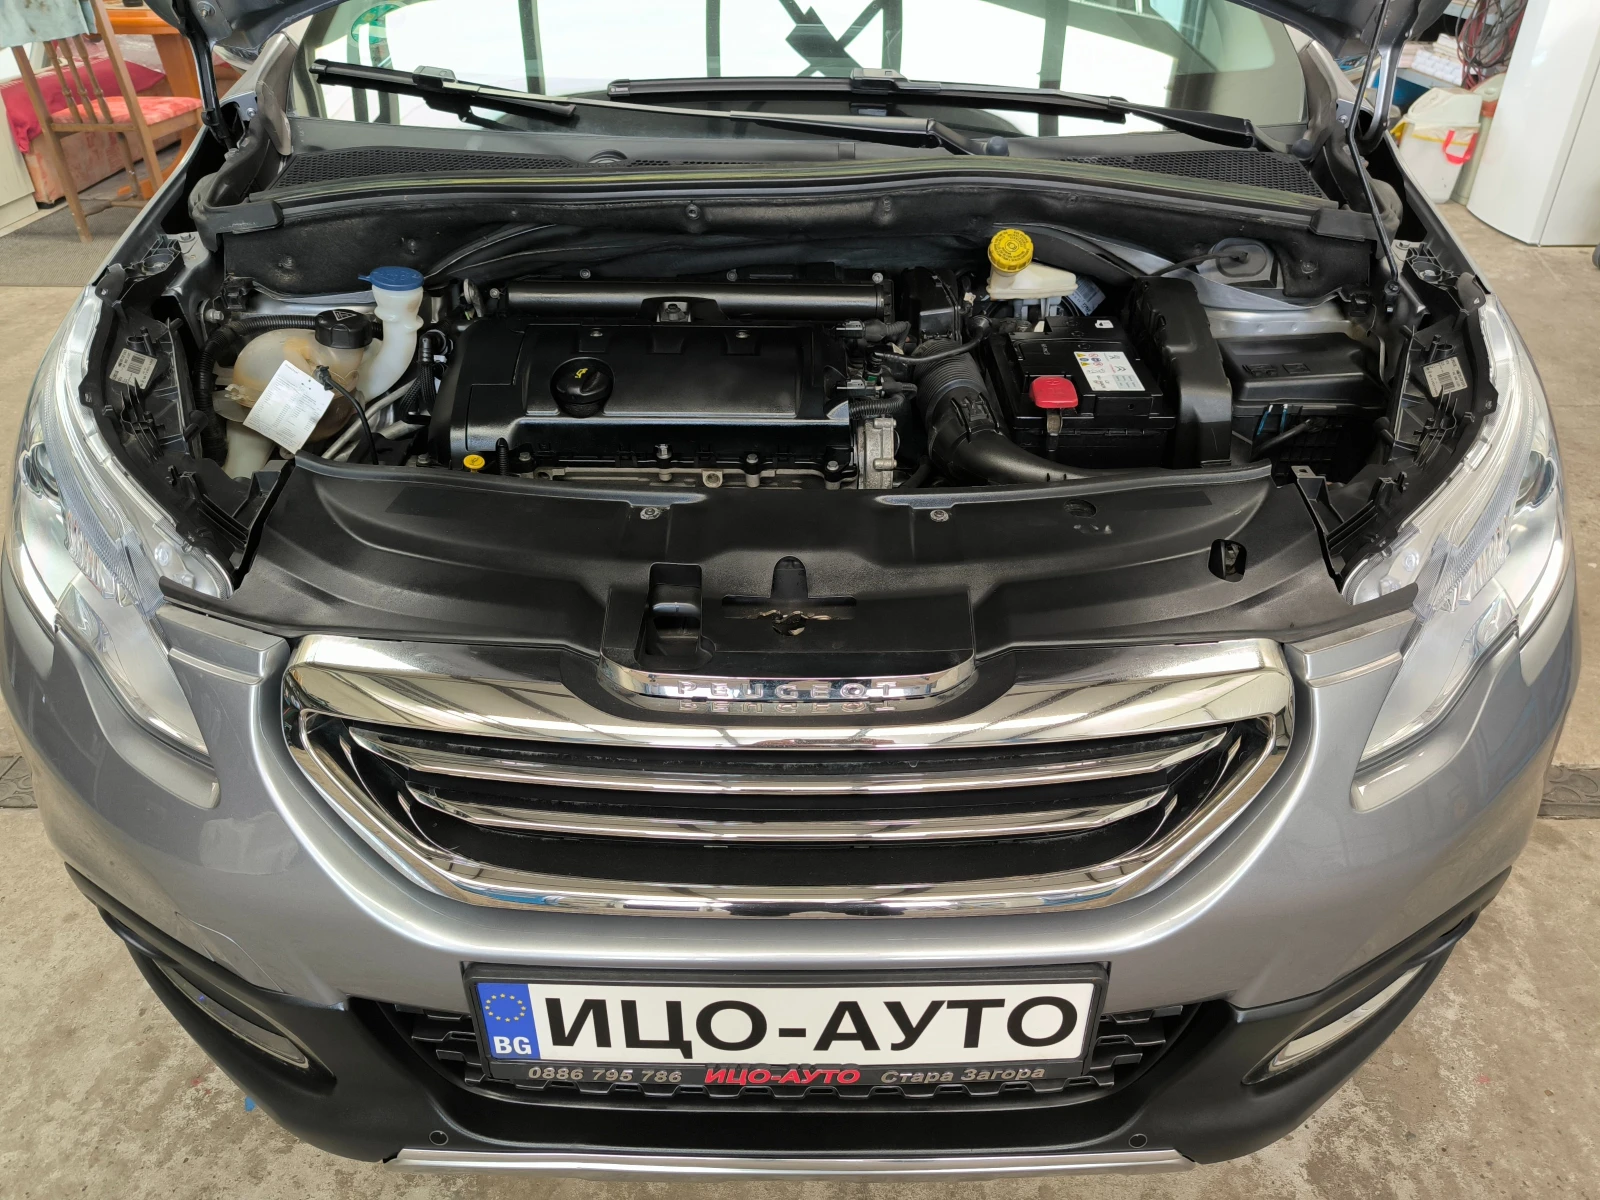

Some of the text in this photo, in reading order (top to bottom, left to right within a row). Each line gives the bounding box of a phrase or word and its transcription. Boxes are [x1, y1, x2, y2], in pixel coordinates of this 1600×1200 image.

[677, 679, 898, 699] PEUGEOT
[545, 995, 1078, 1060] ИЦО-АУТО
[493, 1036, 532, 1055] BG
[528, 1066, 1046, 1086] 0886 795 786 ИЦО-АУТО Стара Загора
